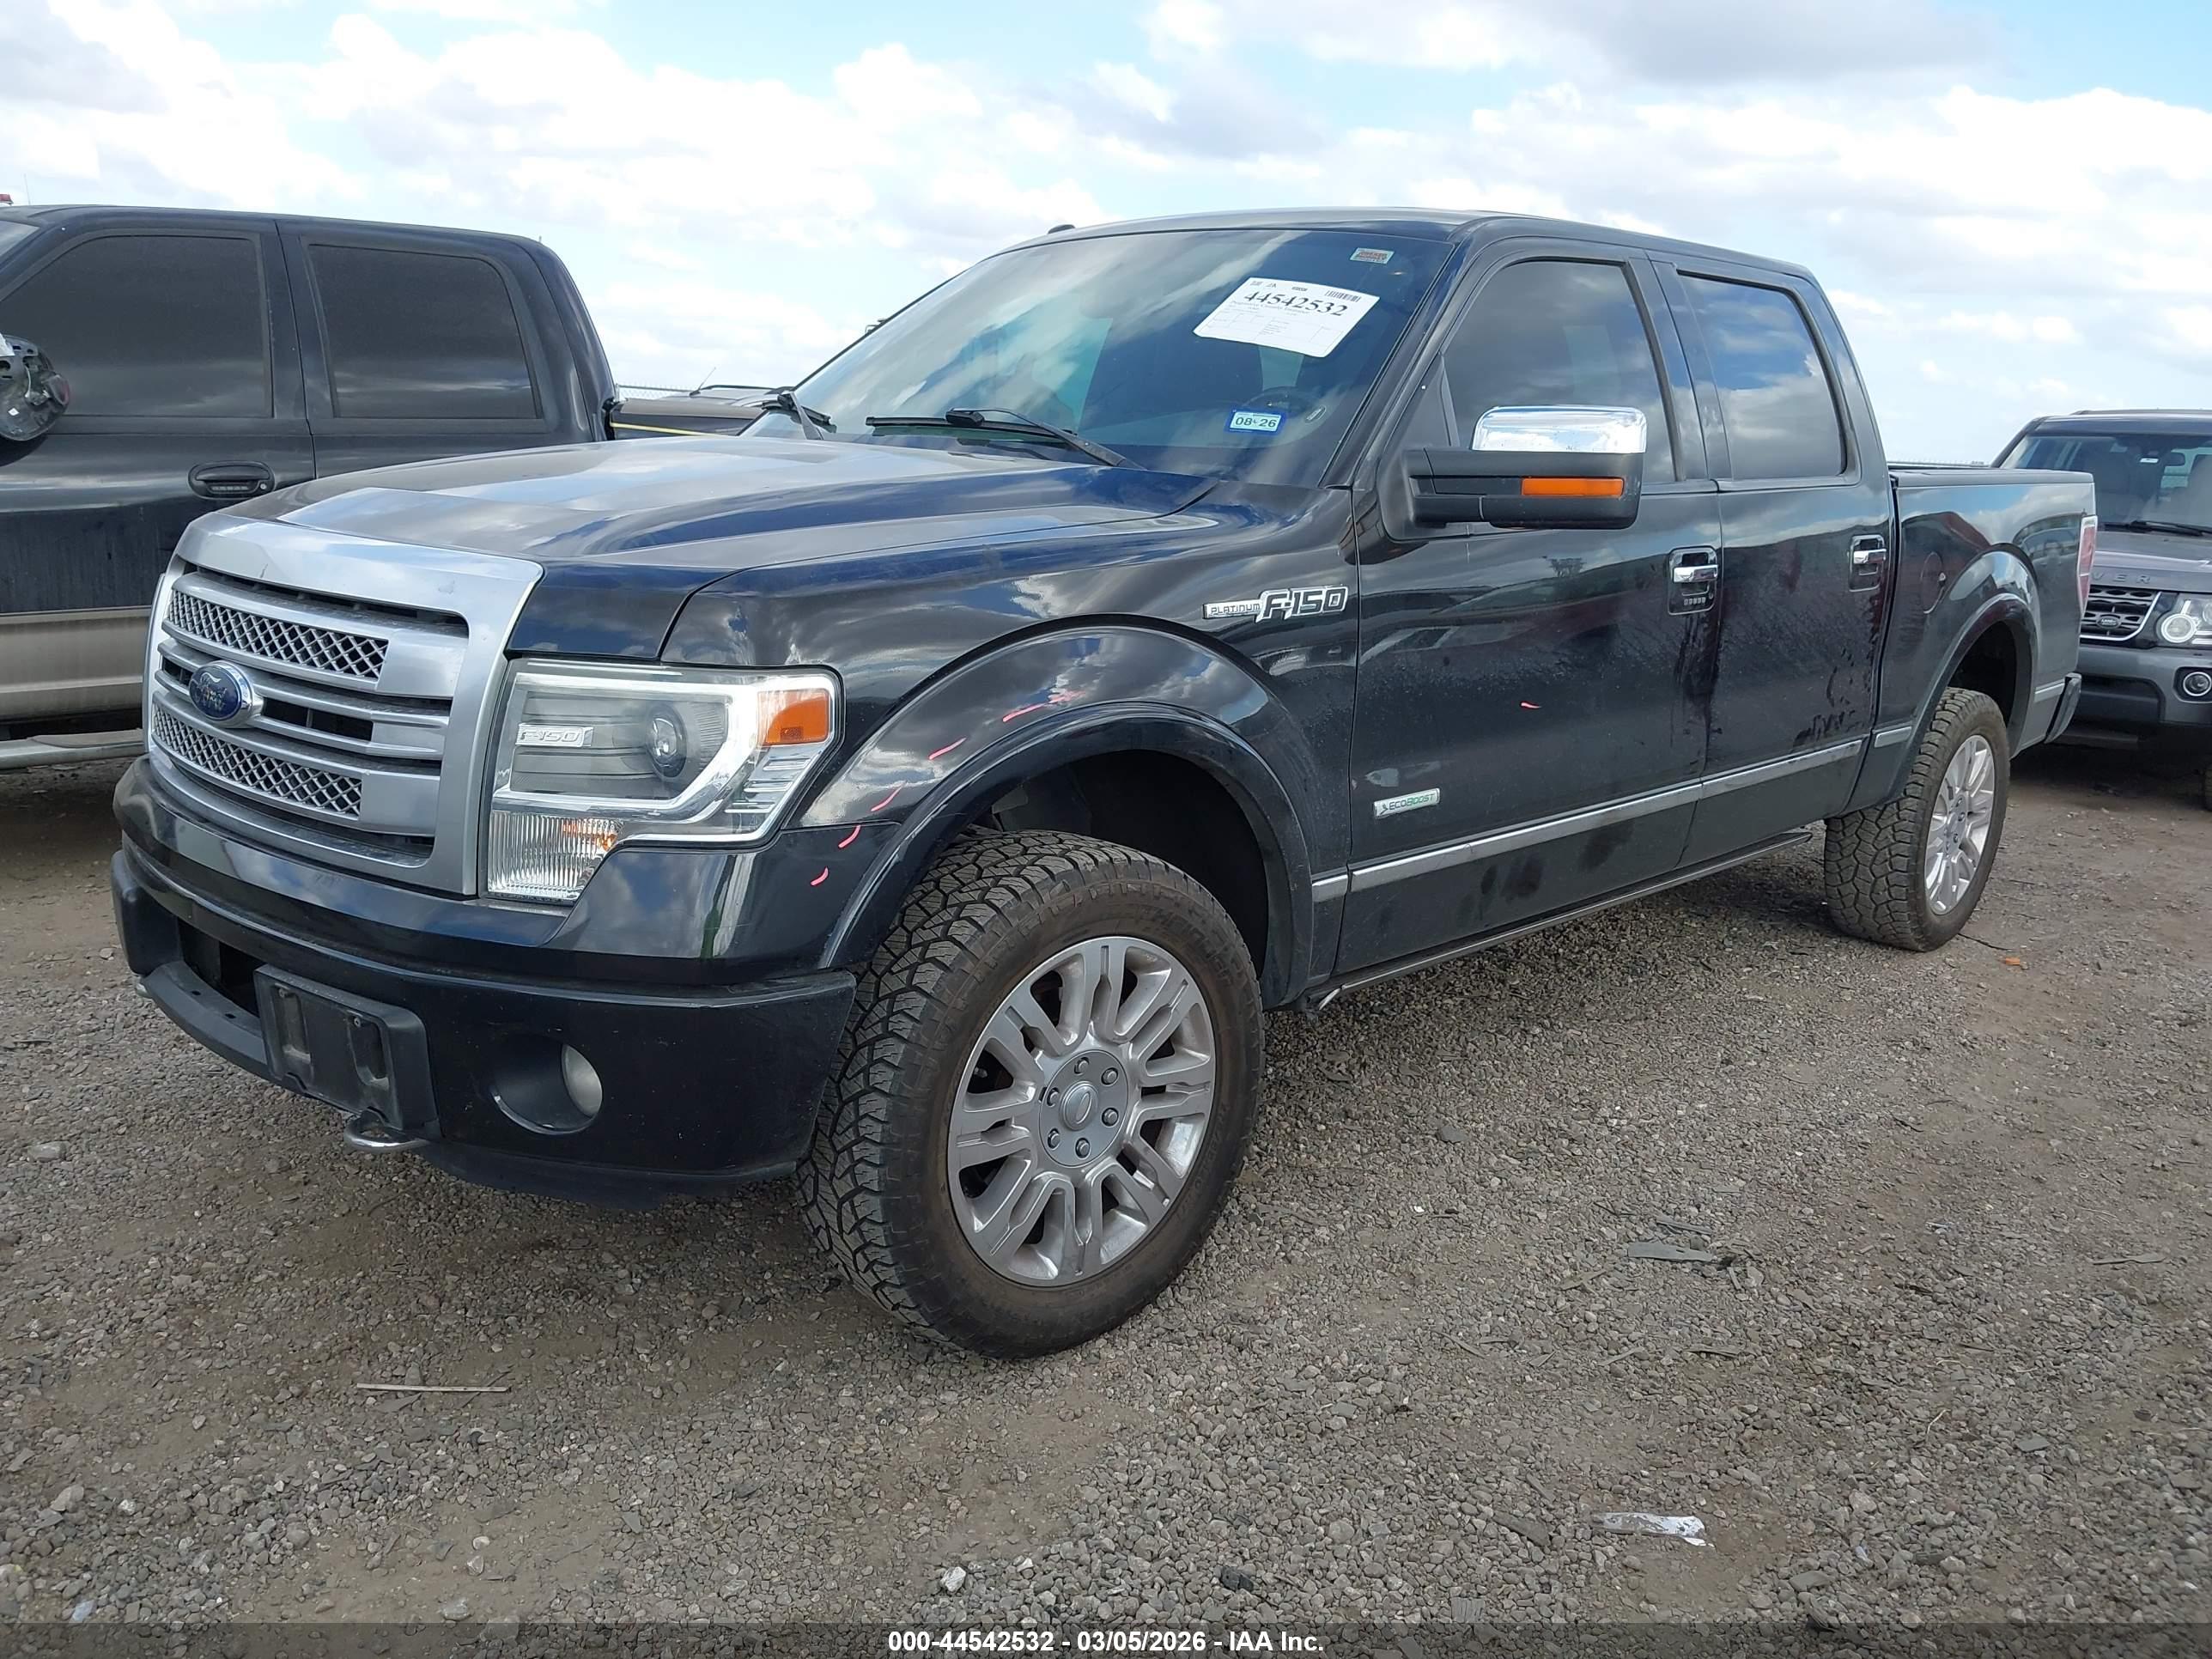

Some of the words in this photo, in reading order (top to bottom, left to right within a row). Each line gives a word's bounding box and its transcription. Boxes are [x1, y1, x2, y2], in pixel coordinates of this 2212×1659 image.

[1244, 290, 1348, 317] 44542532
[1235, 416, 1253, 427] 08
[1258, 418, 1278, 428] 26
[2091, 572, 2151, 585] VER
[1210, 602, 1261, 615] PLATINUM
[1258, 586, 1349, 623] F-150
[520, 730, 580, 743] F-150
[1389, 793, 1437, 811] ECOBOOST
